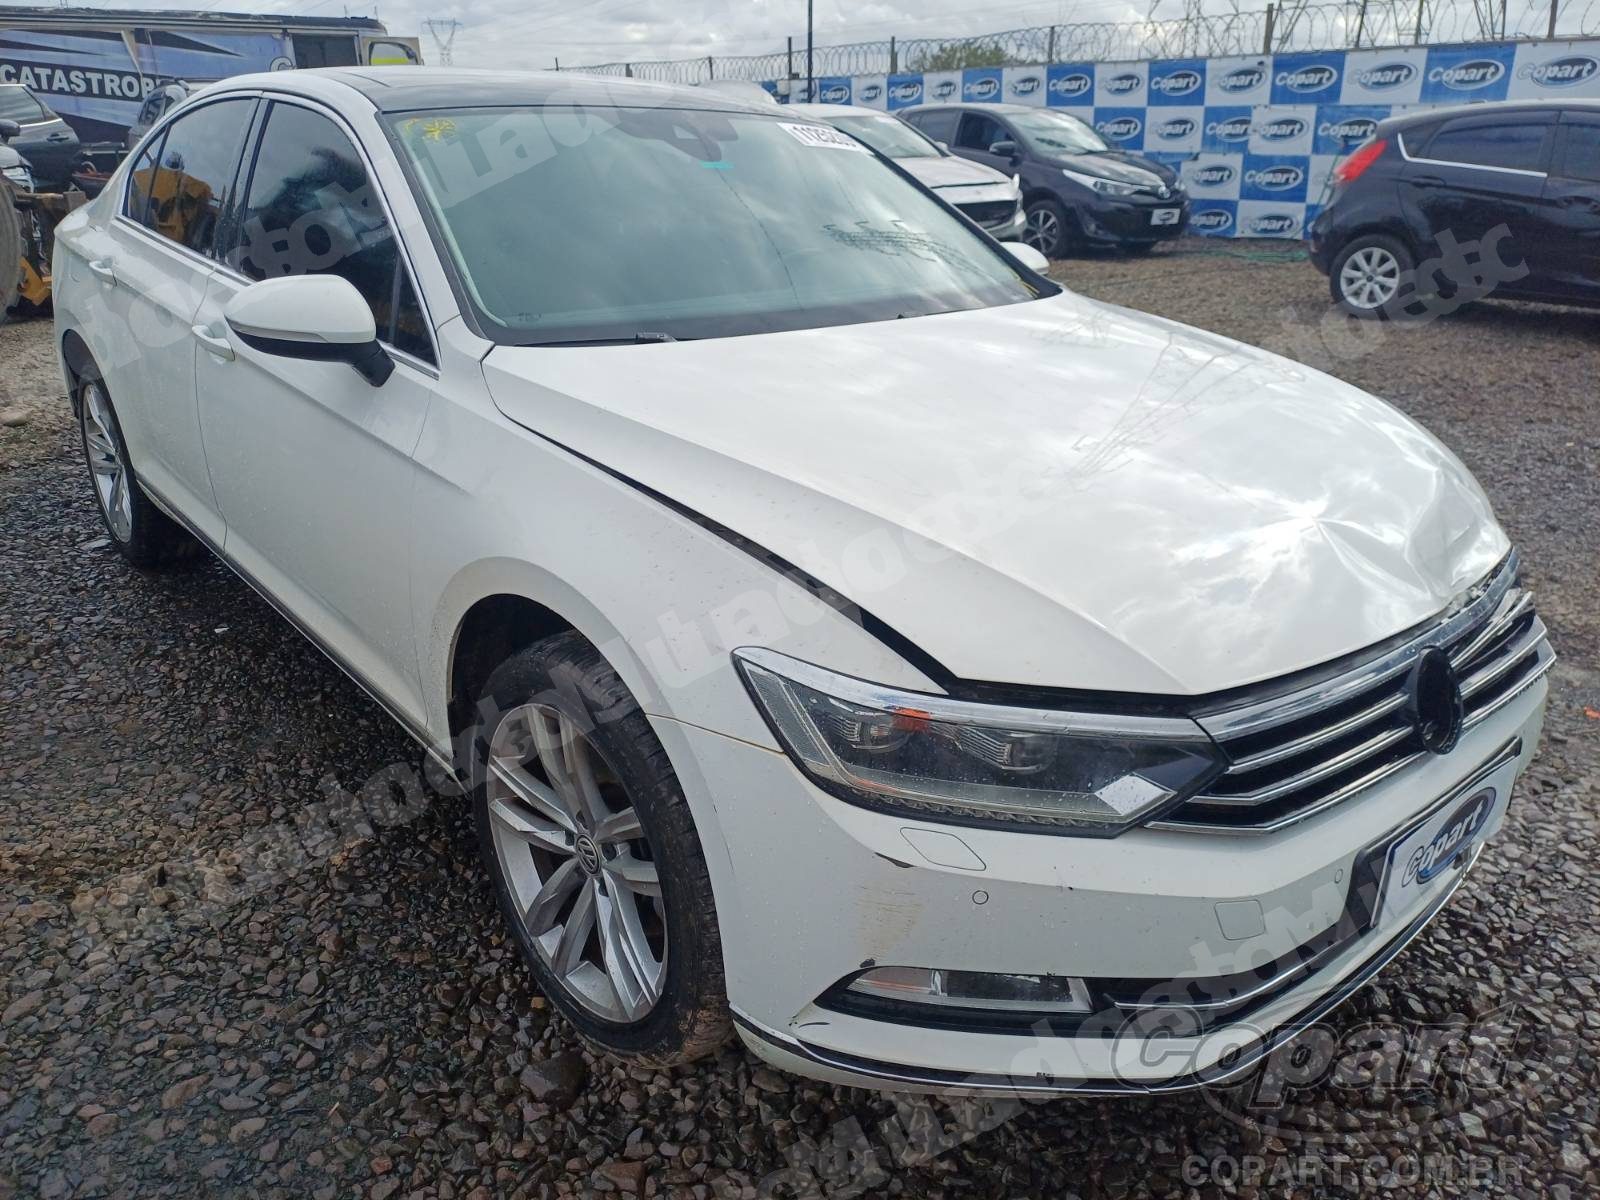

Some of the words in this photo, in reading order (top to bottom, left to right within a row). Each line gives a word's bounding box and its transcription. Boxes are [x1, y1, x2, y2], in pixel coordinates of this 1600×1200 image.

[1275, 69, 1331, 88] Copart
[1428, 62, 1499, 85] Copart
[1517, 59, 1595, 81] Copart
[0, 64, 163, 99] CATASTROP
[1049, 78, 1087, 93] Copart
[1151, 74, 1196, 91] Copart
[1221, 72, 1261, 88] opart
[1096, 120, 1137, 136] Copart
[1157, 121, 1193, 136] opart
[1206, 121, 1250, 137] Copar
[1258, 121, 1302, 138] opart
[1318, 120, 1376, 139] Copart
[1193, 168, 1231, 183] opart
[1245, 168, 1296, 186] Copart
[1251, 217, 1291, 232] opart
[1402, 798, 1486, 888] Copart
